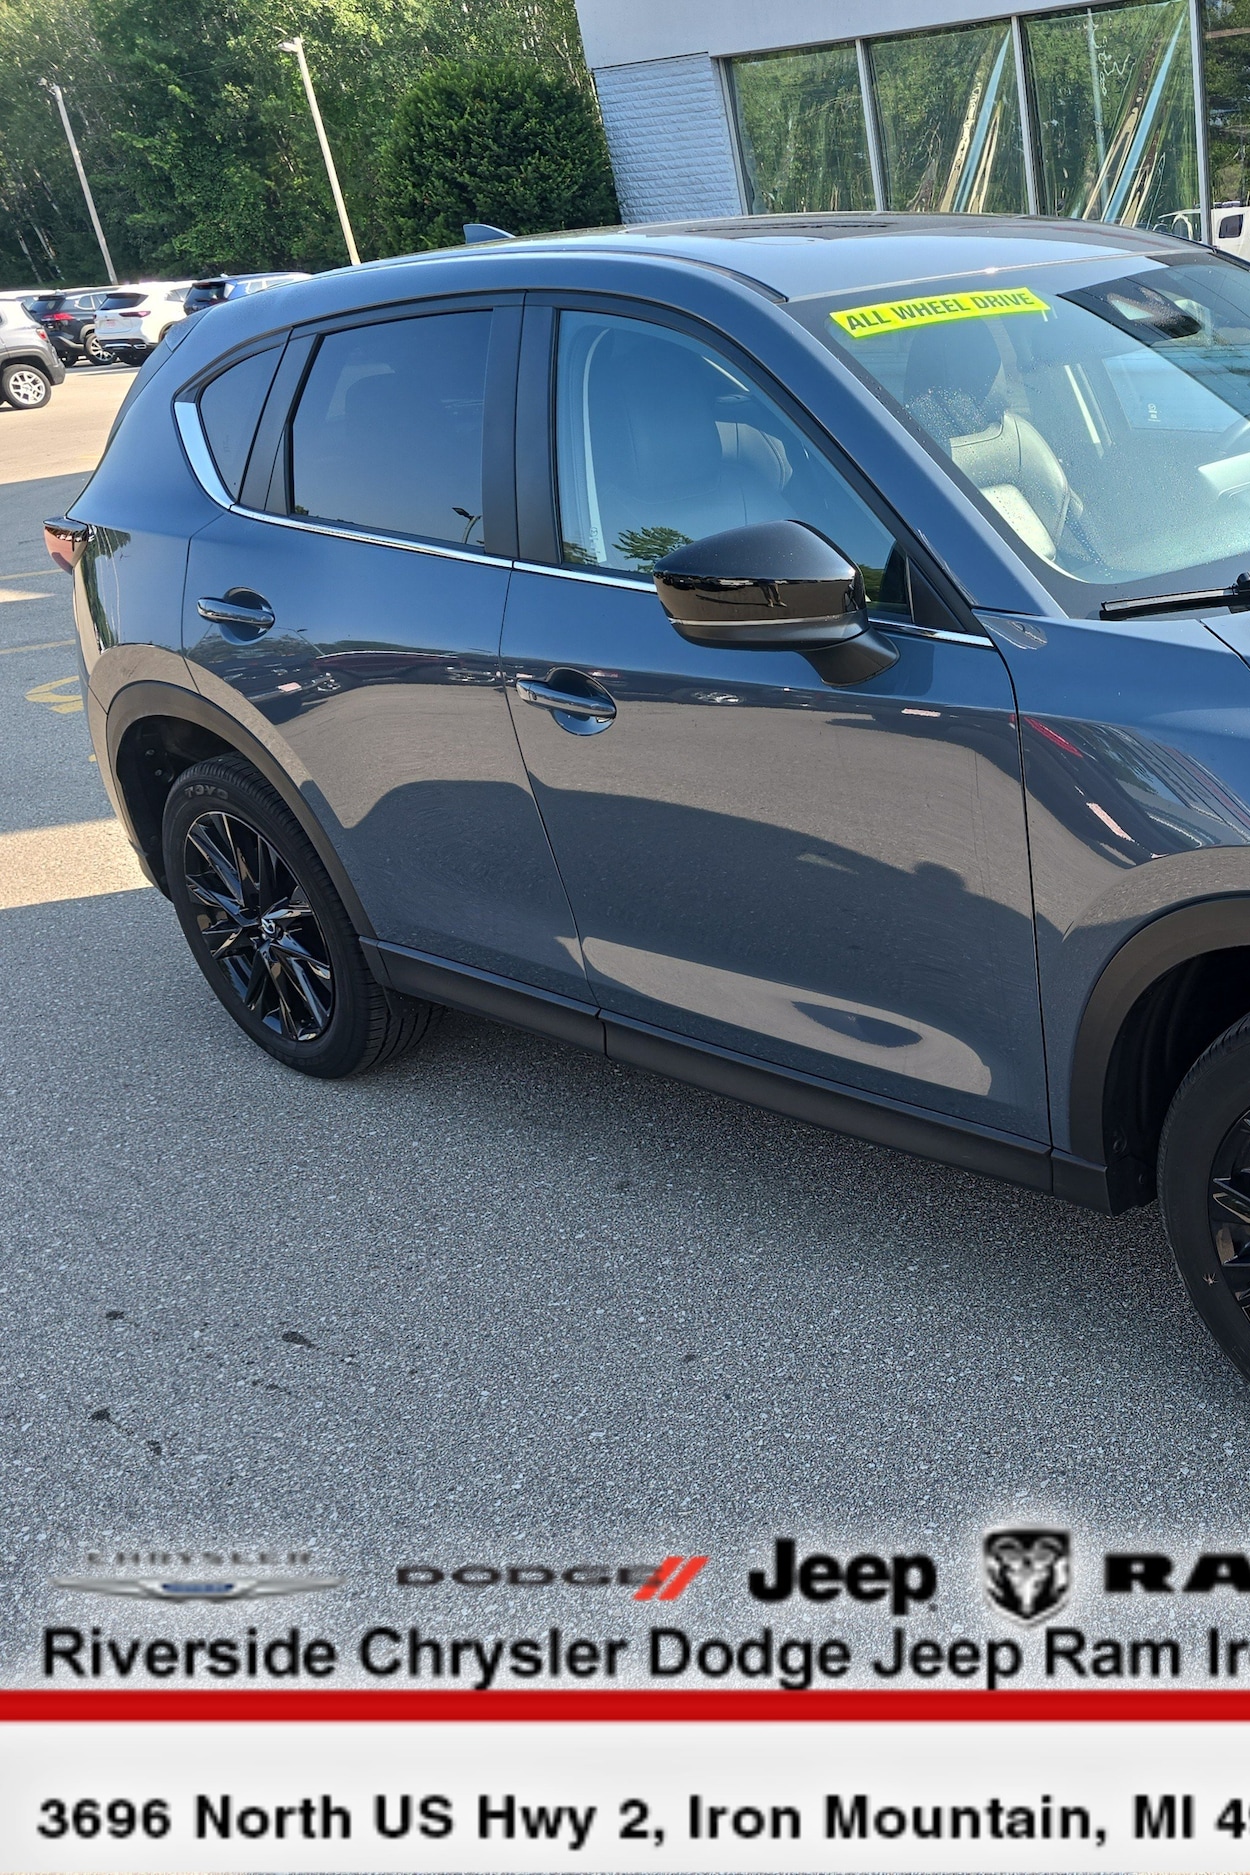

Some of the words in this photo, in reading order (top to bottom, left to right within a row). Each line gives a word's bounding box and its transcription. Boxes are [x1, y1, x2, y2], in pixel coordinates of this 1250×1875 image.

[846, 311, 891, 331] ALL
[889, 299, 971, 320] WHEEL
[970, 293, 1035, 309] DRIVE
[184, 784, 229, 800] TOYO
